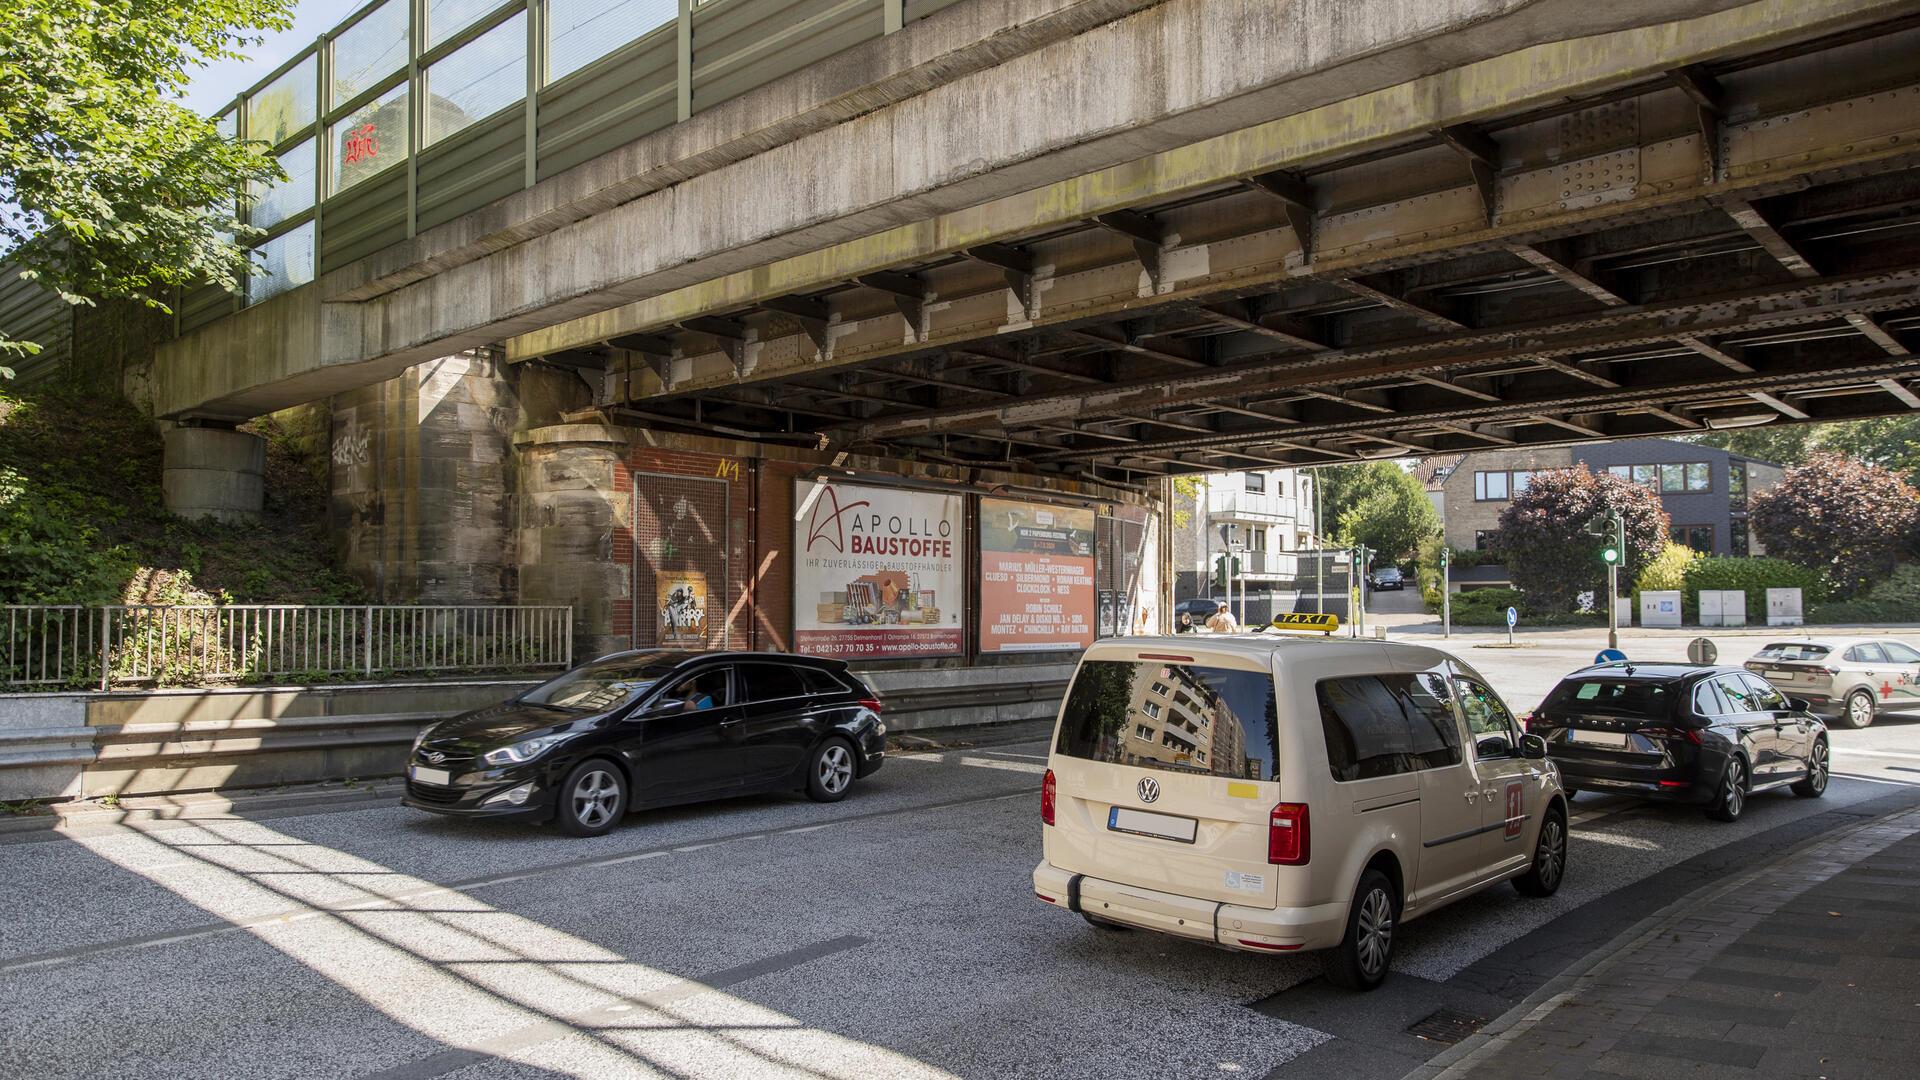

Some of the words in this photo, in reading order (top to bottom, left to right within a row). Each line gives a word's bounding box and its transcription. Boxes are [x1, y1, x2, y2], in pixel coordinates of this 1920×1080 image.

[851, 513, 951, 538] APOLLO
[851, 535, 952, 558] BAUSTOFFE
[806, 558, 819, 567] IHR
[823, 558, 884, 570] ZUVERLÄSSIGER
[985, 572, 1008, 582] CLUESO
[1000, 613, 1011, 624] JAN
[1012, 614, 1029, 624] DELAY
[1281, 613, 1323, 624] TAXI
[990, 625, 1016, 635] MONTEZ
[800, 645, 815, 654] Tel.:
[816, 644, 843, 653] 0421-37
[845, 644, 854, 652] 70
[855, 644, 864, 652] 70
[865, 643, 874, 652] 35
[881, 642, 958, 652] www.apollo-baustoffe.de
